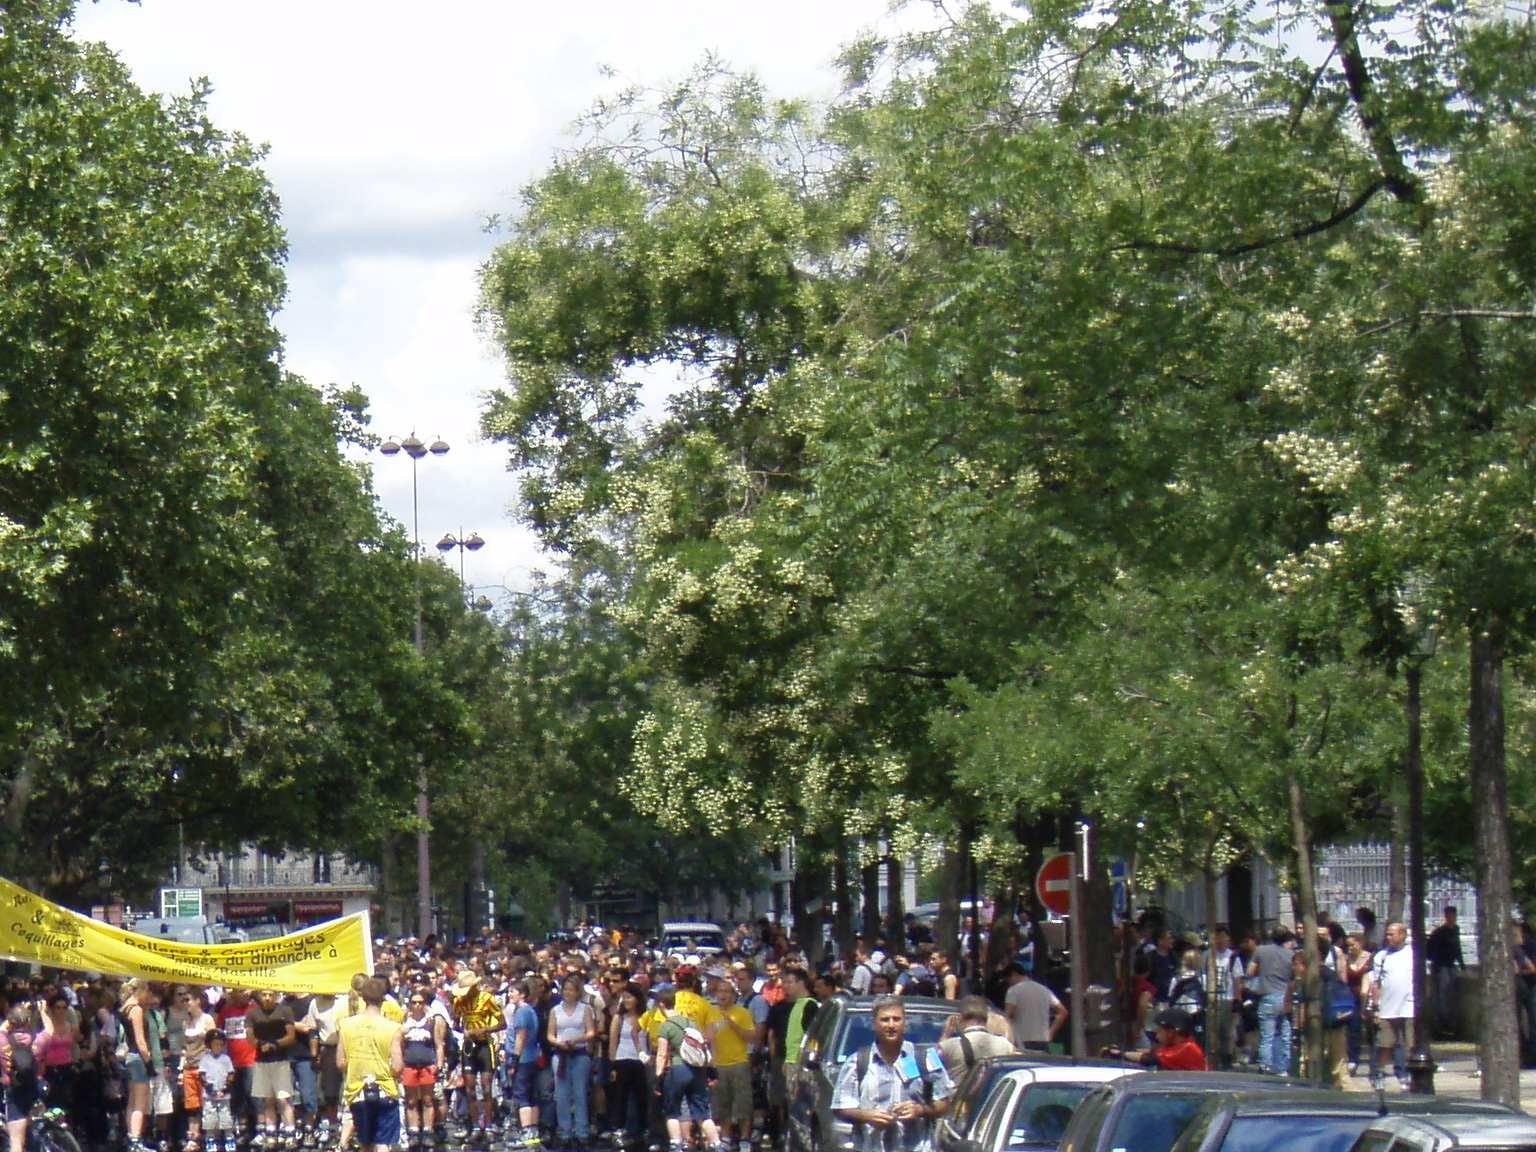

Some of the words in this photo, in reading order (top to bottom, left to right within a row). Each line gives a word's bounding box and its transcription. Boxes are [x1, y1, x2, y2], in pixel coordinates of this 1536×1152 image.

[31, 909, 45, 926] &
[11, 922, 85, 950] Coquillages
[231, 953, 244, 966] du
[251, 947, 322, 966] dimanche
[329, 944, 339, 959] à
